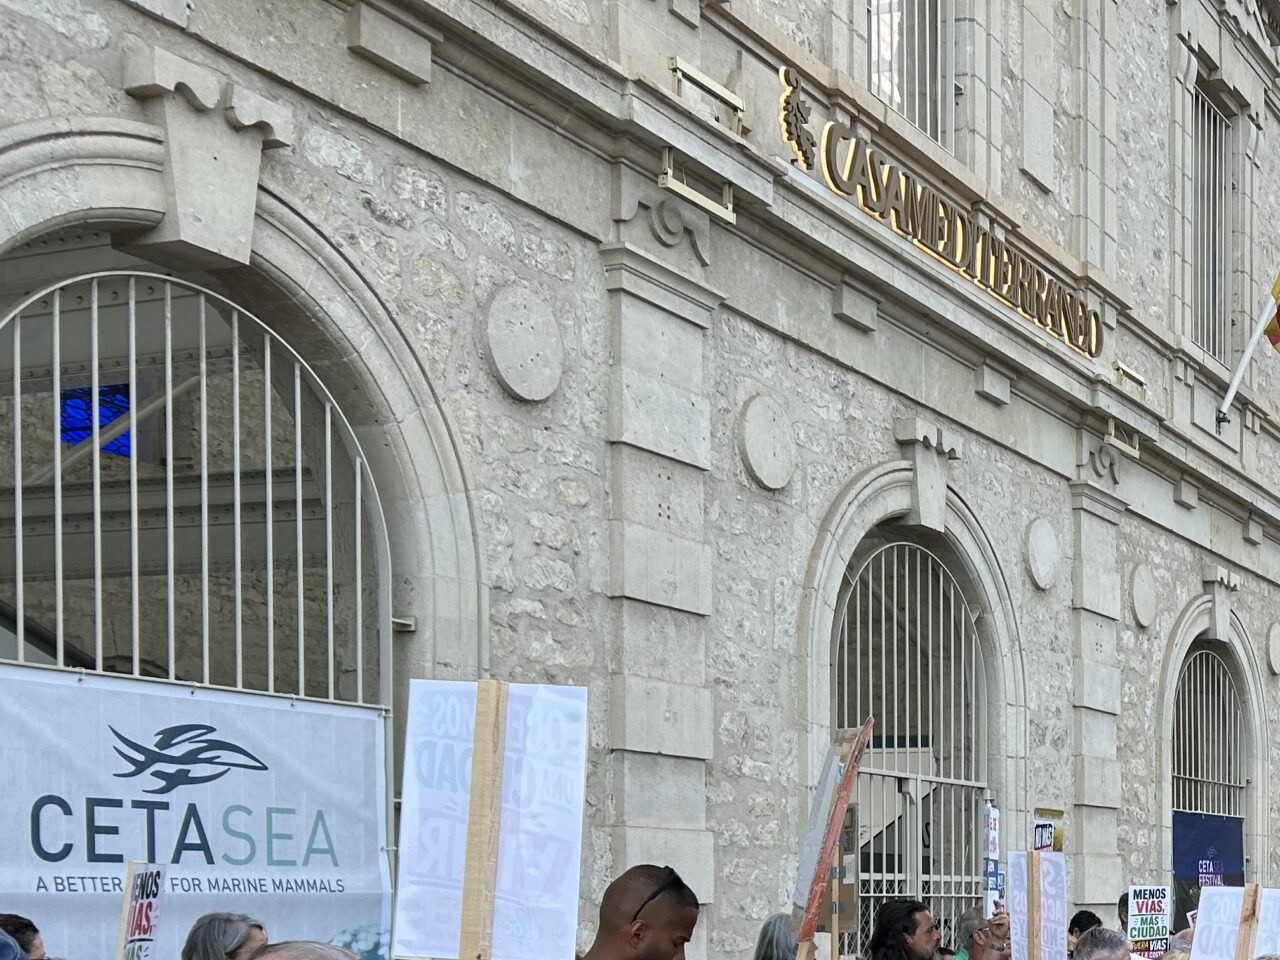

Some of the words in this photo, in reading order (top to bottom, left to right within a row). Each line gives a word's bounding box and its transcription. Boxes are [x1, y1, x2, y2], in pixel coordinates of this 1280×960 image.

[30, 794, 339, 867] CETASEA
[36, 876, 48, 892] A
[54, 876, 123, 893] BETTER
[171, 877, 203, 893] FOR
[207, 877, 267, 893] MARINE
[271, 878, 345, 894] MAMMALS
[1198, 874, 1224, 886] FESTIVAL
[1133, 888, 1166, 900] MENOS
[1136, 899, 1165, 913] VÍAS,
[1140, 915, 1159, 926] MÁS
[1130, 925, 1167, 938] CIUDAD
